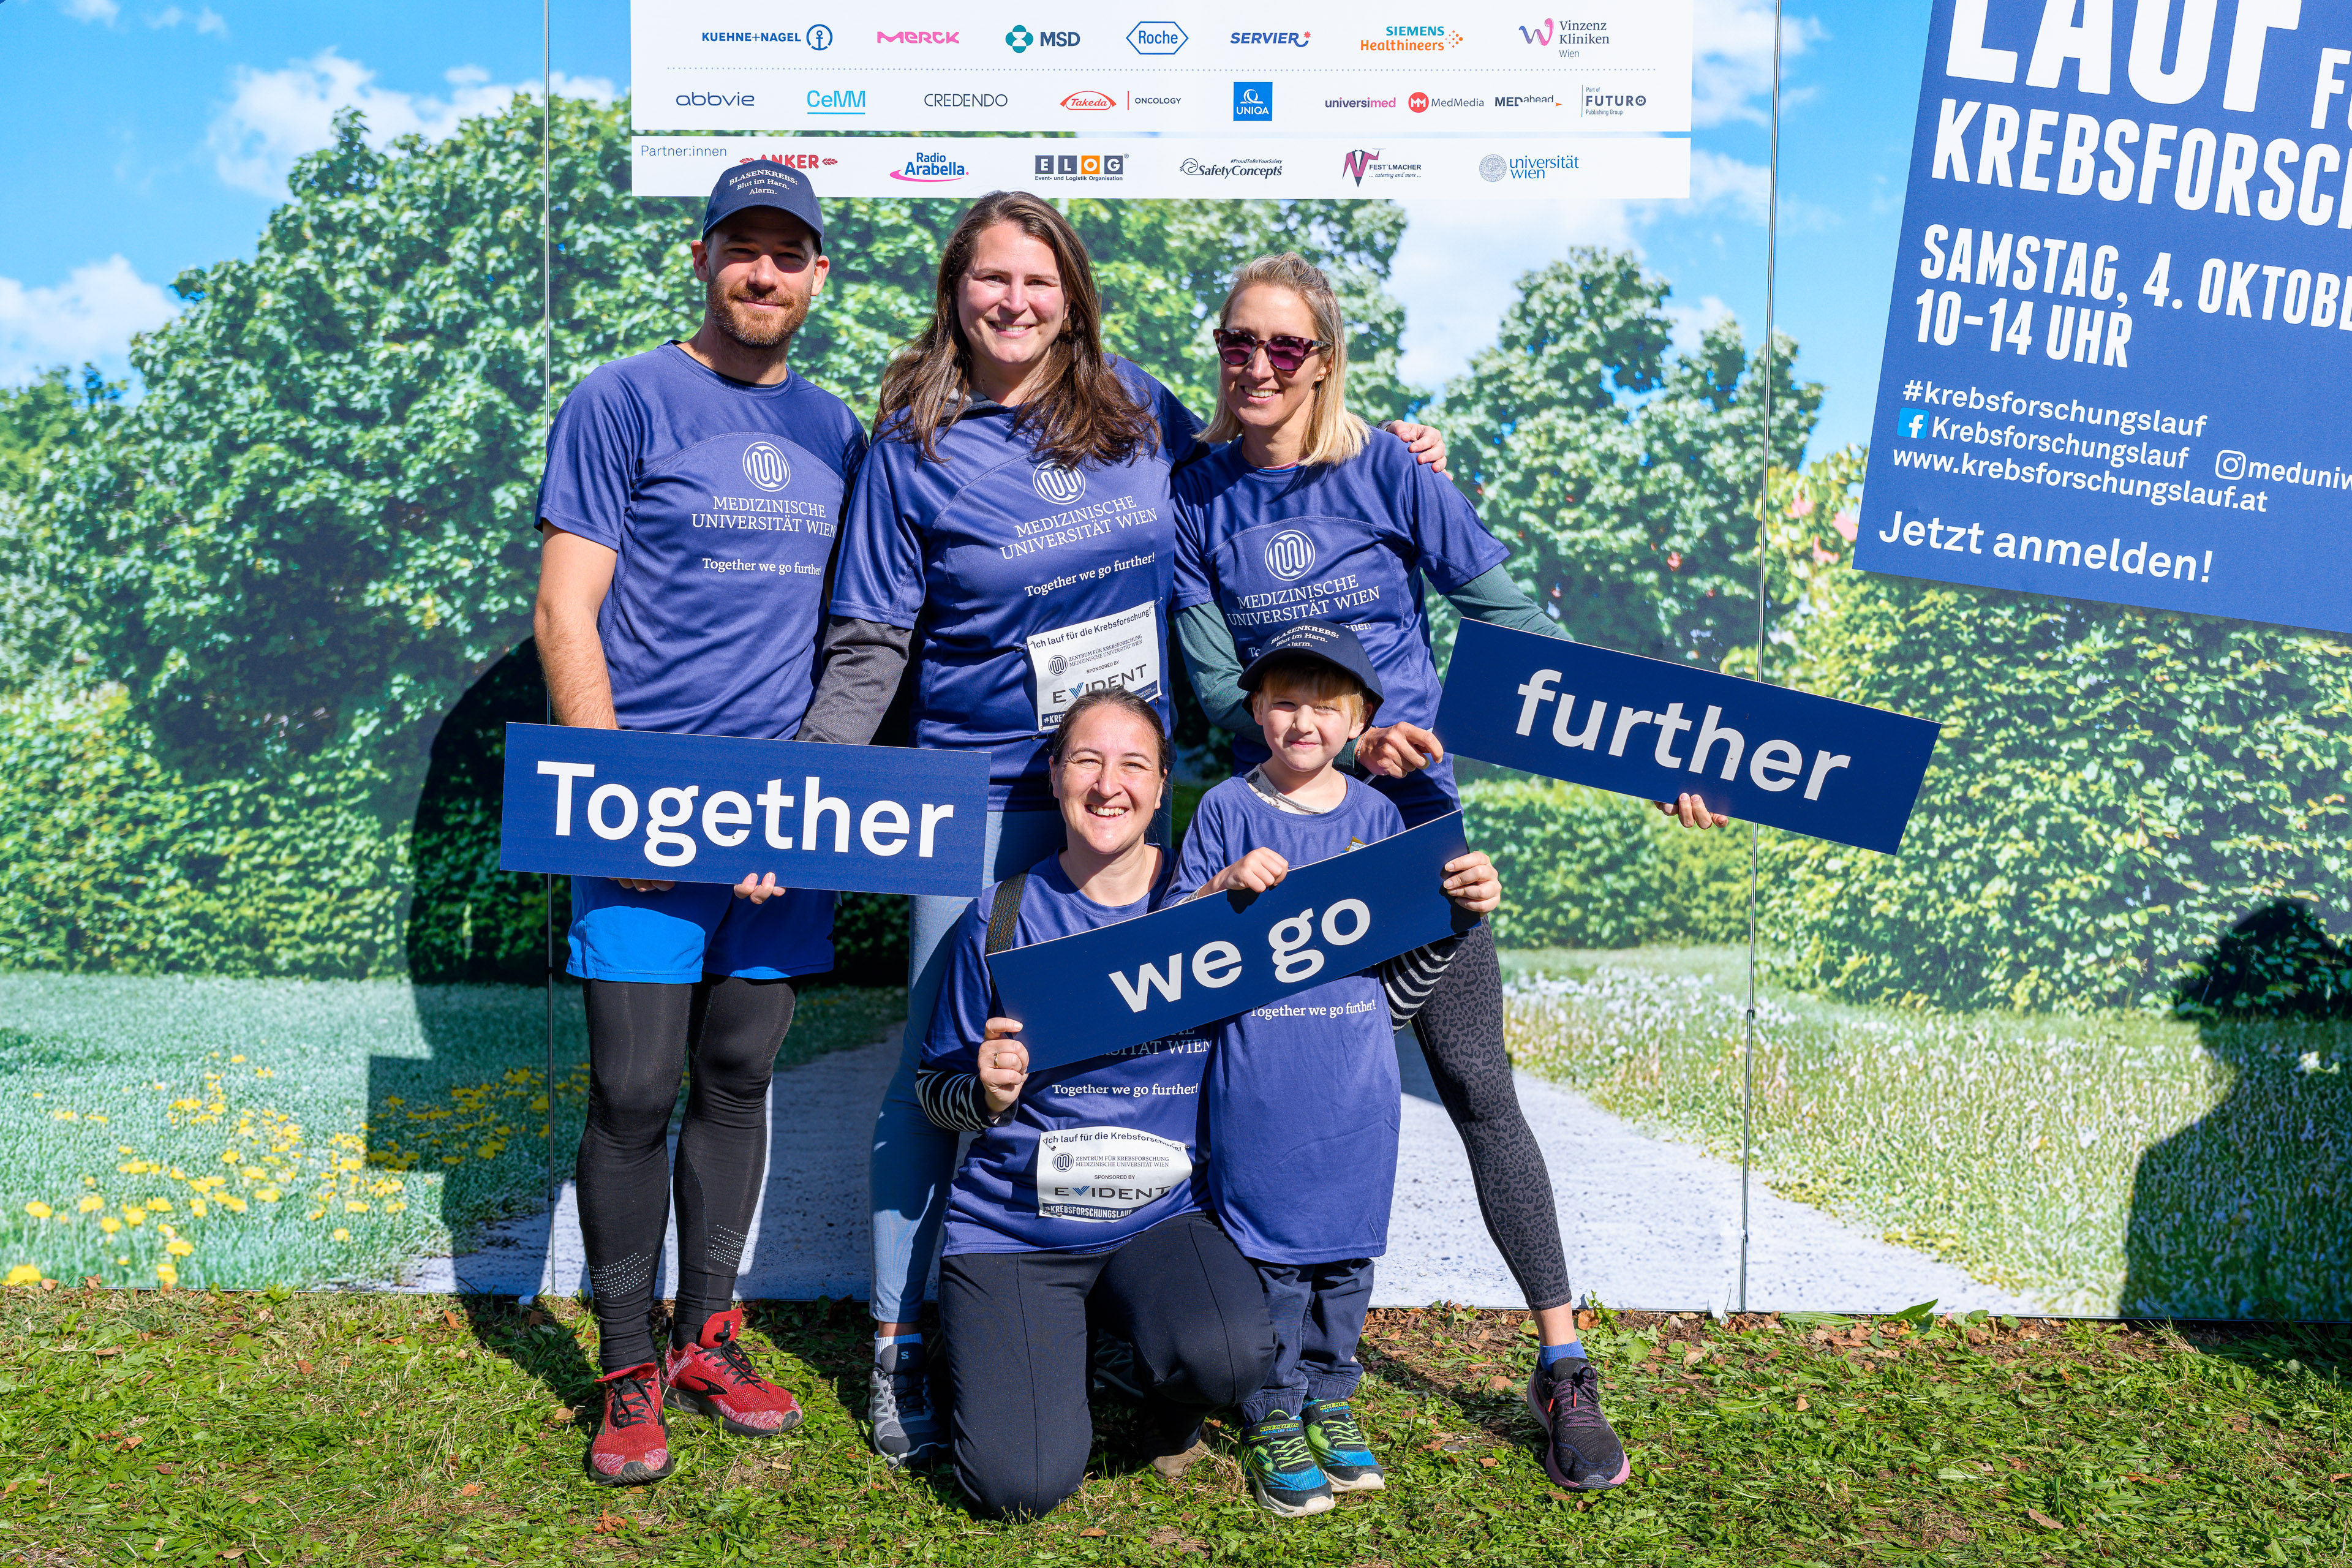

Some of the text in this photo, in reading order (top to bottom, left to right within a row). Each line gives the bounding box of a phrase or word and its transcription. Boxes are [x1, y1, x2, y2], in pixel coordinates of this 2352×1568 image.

[1386, 26, 1445, 36] SIEMENS
[1559, 20, 1607, 31] Vinzenz
[702, 32, 802, 42] KUEHNE+NAGEL
[1040, 31, 1080, 47] MSD
[1138, 30, 1178, 44] Roche
[1230, 32, 1308, 48] SERVIER
[1360, 39, 1444, 51] Healthineers
[1559, 33, 1610, 44] Kliniken
[1559, 49, 1580, 58] Wien
[676, 91, 755, 107] abbvie
[807, 89, 865, 108] CeMM
[924, 93, 1008, 107] CREDENDO
[1325, 97, 1396, 108] universimed
[1431, 97, 1484, 107] MedMedia
[1586, 95, 1646, 107] FUTURO
[1236, 106, 1270, 115] UNIQA
[641, 145, 726, 157] Partner:innen
[916, 152, 946, 164] Radio
[1509, 155, 1580, 168] universität
[729, 170, 797, 186] BLASENKREBS:
[1510, 169, 1545, 179] wien
[737, 180, 753, 190] Blut
[767, 179, 790, 189] Harn.
[1920, 224, 2128, 309] SAMSTAG,
[2143, 252, 2182, 309] 4.
[2046, 306, 2132, 368] UHR
[1902, 379, 2207, 437] #krebsforschungslauf
[1932, 417, 2189, 469] Krebsforschungslauf
[1893, 448, 2267, 513] www.krebsforschungslauf.at
[713, 496, 826, 518] MEDIZINISCHE
[1014, 496, 1137, 538] MEDIZINISCHE
[692, 514, 836, 538] UNIVERSITÄT WIEN
[1000, 508, 1158, 560] UNIVERSITÄT WIEN
[1879, 511, 2213, 582] Jetzt anmelden!
[703, 558, 756, 573] Together
[779, 565, 792, 575] go
[794, 562, 821, 575] further!
[1025, 552, 1155, 597] Together we go further!
[1237, 575, 1359, 609] MEDIZINISCHE
[1227, 586, 1380, 627] UNIVERSITÄT WIEN
[1048, 634, 1064, 645] lauf
[1066, 631, 1078, 640] für
[1080, 628, 1093, 637] die
[1271, 625, 1339, 644] BLASENKREBS:
[1276, 636, 1291, 647] Blut
[1304, 633, 1328, 643] Harn.
[1069, 651, 1092, 662] ZENTRUM
[1103, 635, 1142, 652] KREBSFORSCHUNG
[1069, 654, 1103, 667] MEDIZINISCHE
[1087, 662, 1114, 674] SPONSORED
[1516, 669, 1851, 801] further
[537, 761, 954, 867] Together
[1109, 899, 1371, 1013] we go
[1251, 1005, 1306, 1020] Together
[1330, 1006, 1344, 1018] go
[1346, 1000, 1376, 1014] further!
[1052, 1084, 1109, 1096] Together
[1133, 1087, 1148, 1098] go
[1152, 1083, 1199, 1095] further!
[1061, 1134, 1078, 1143] lauf
[1260, 1423, 1299, 1432] SKECHERS
